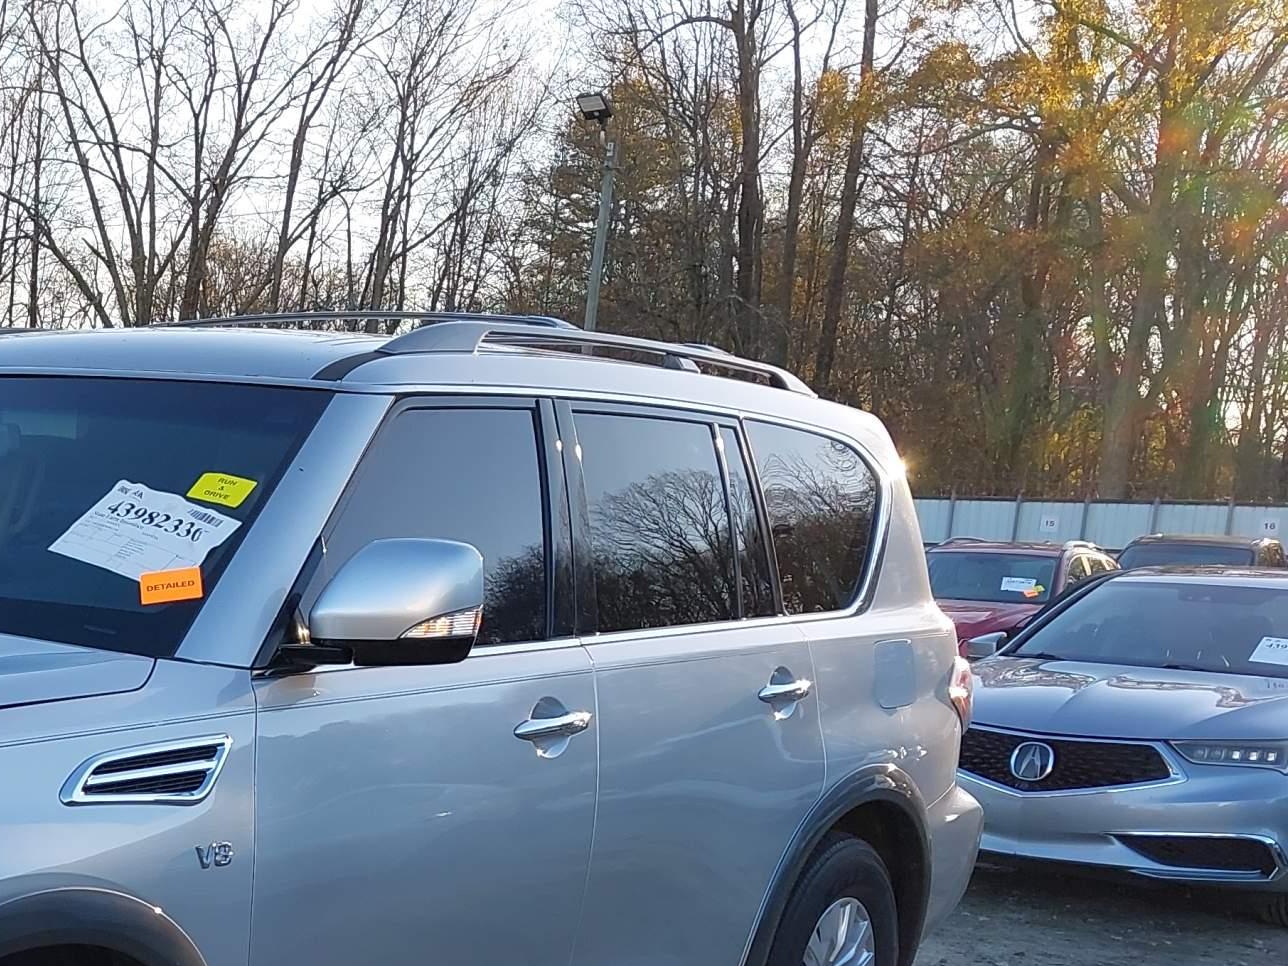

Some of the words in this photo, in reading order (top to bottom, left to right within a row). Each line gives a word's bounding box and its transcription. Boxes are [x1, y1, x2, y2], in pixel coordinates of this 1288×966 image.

[217, 477, 238, 486] RUN
[203, 490, 231, 500] DRIVE
[146, 580, 195, 592] DETAILED
[195, 841, 233, 869] V8
